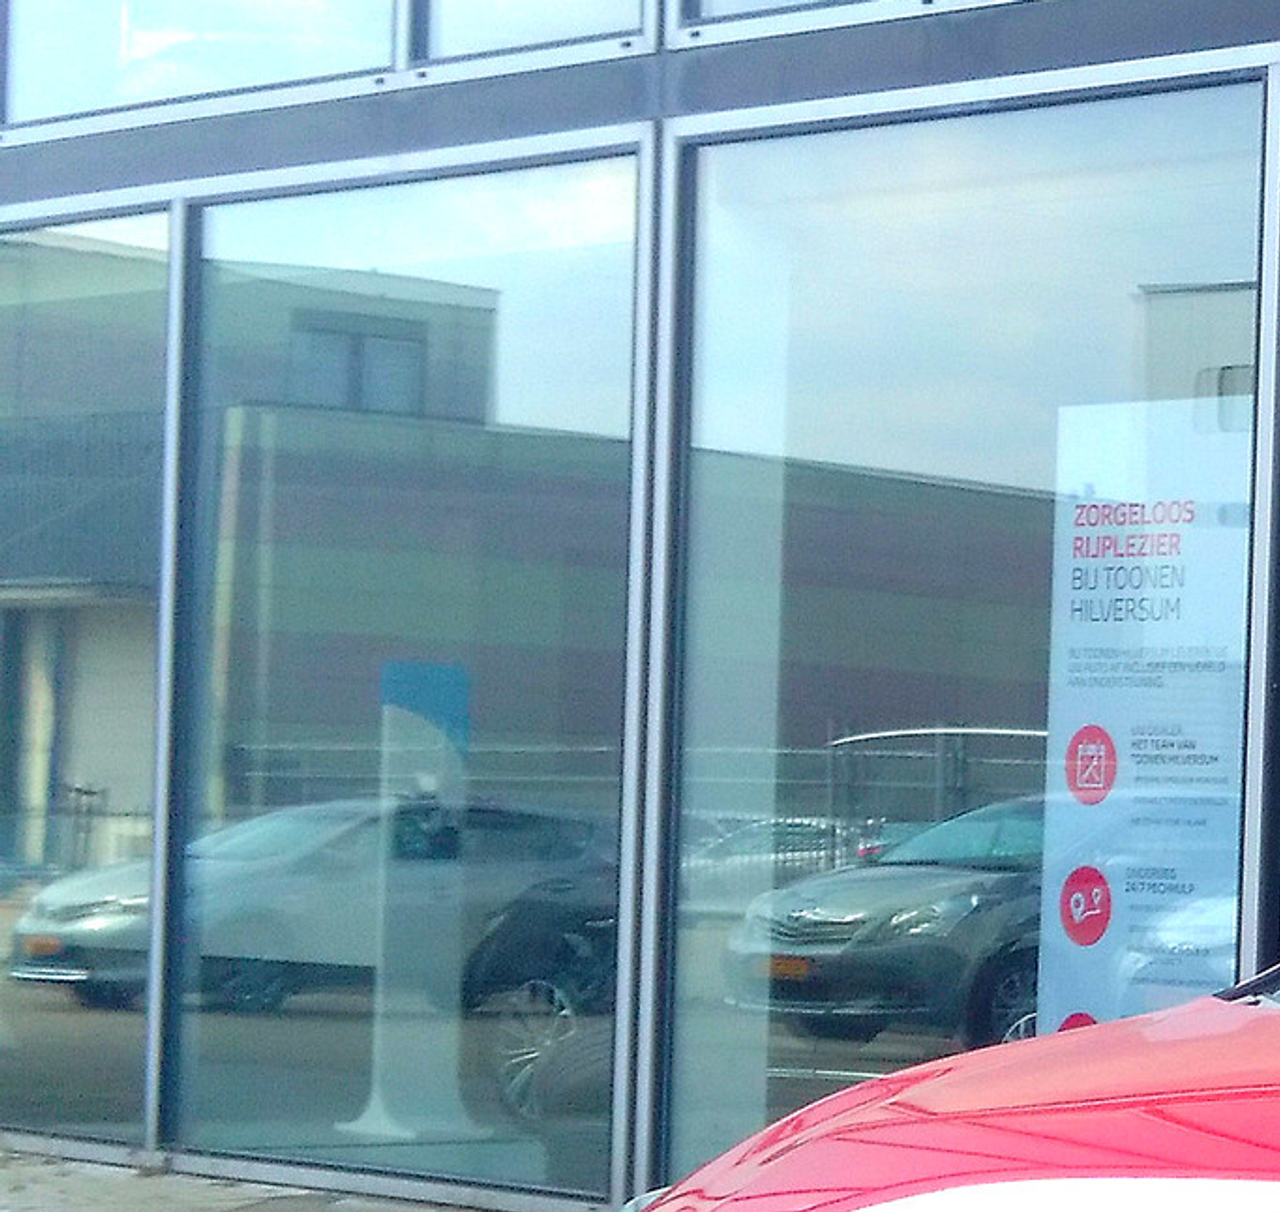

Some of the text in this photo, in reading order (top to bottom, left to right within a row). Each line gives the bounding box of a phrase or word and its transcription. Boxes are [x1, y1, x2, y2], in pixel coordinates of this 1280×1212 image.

[1073, 500, 1196, 528] ZORGELOOS
[1072, 532, 1181, 559] RIJPLEZIER
[1102, 564, 1186, 591] TOONEN
[1070, 597, 1182, 622] HILVERSUM
